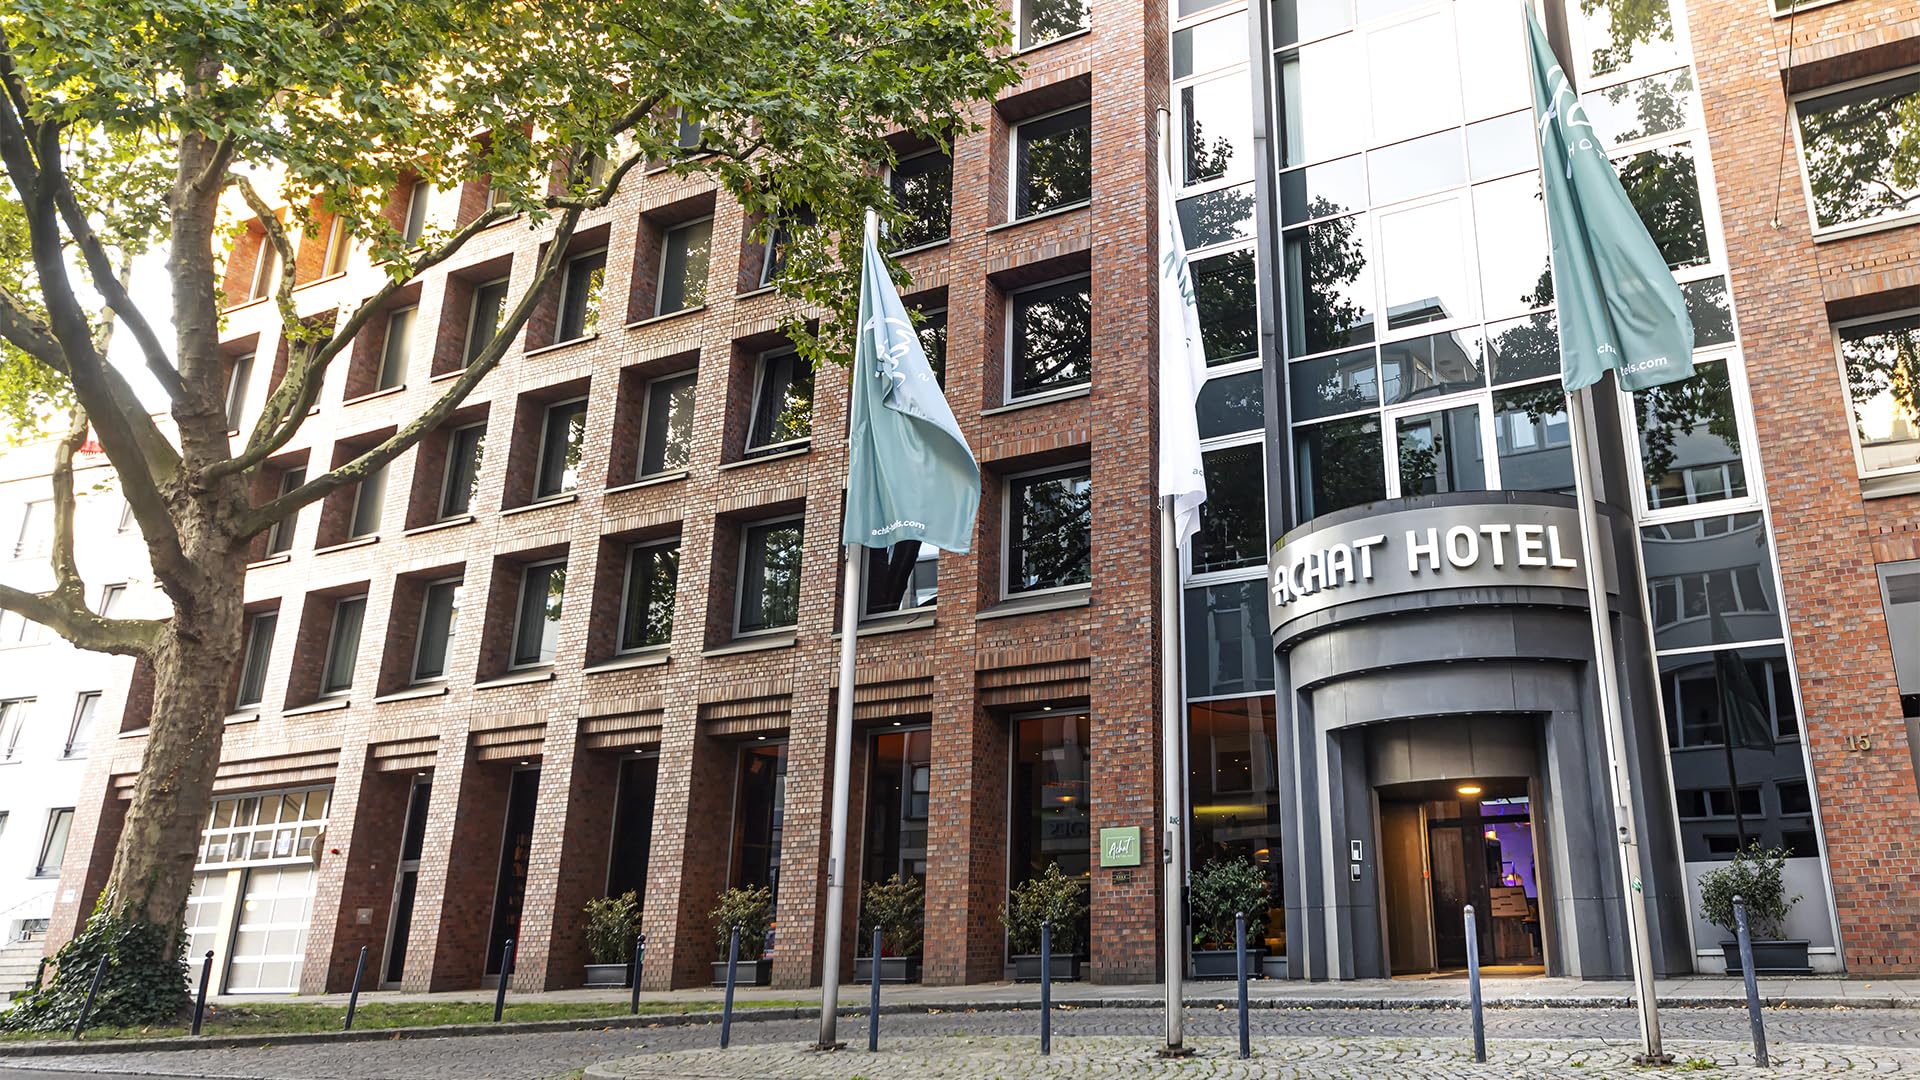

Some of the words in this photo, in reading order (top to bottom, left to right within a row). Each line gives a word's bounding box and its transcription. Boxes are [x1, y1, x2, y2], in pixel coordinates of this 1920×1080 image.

[1271, 533, 1387, 607] ACHAT
[1405, 524, 1578, 574] HOTEL
[1846, 735, 1871, 752] 15
